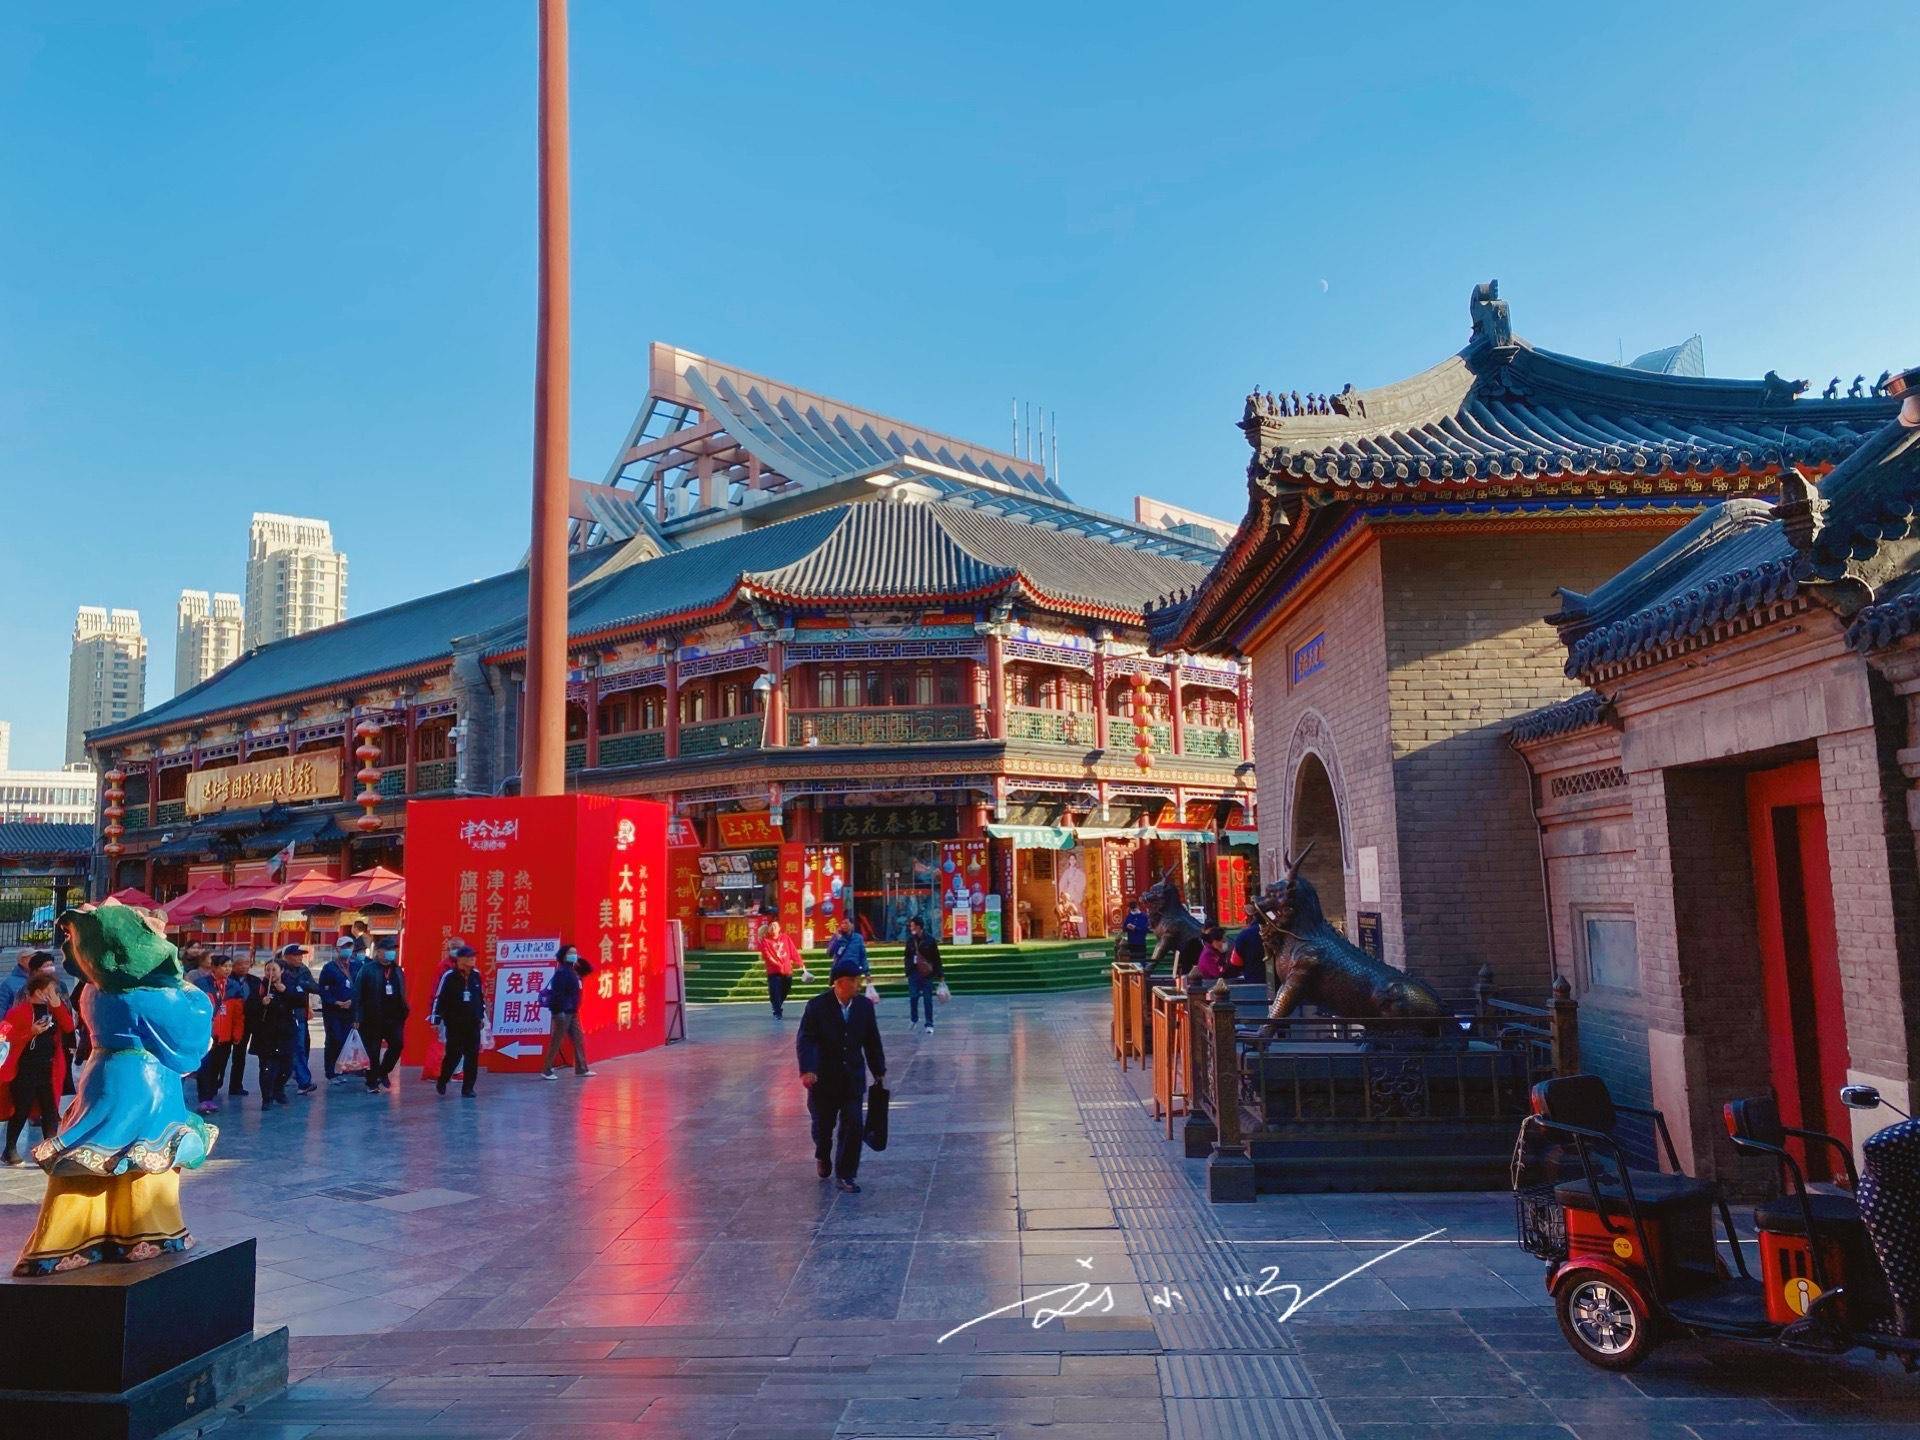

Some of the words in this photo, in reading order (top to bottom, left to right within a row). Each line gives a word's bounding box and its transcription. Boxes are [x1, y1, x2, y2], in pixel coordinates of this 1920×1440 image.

[459, 870, 478, 933] 旗舰店
[598, 898, 614, 1000] 美食坊
[618, 863, 634, 1032] 大狮子胡同
[506, 971, 544, 994] 免費
[499, 1026, 514, 1034] Free
[503, 1001, 541, 1023] 開放
